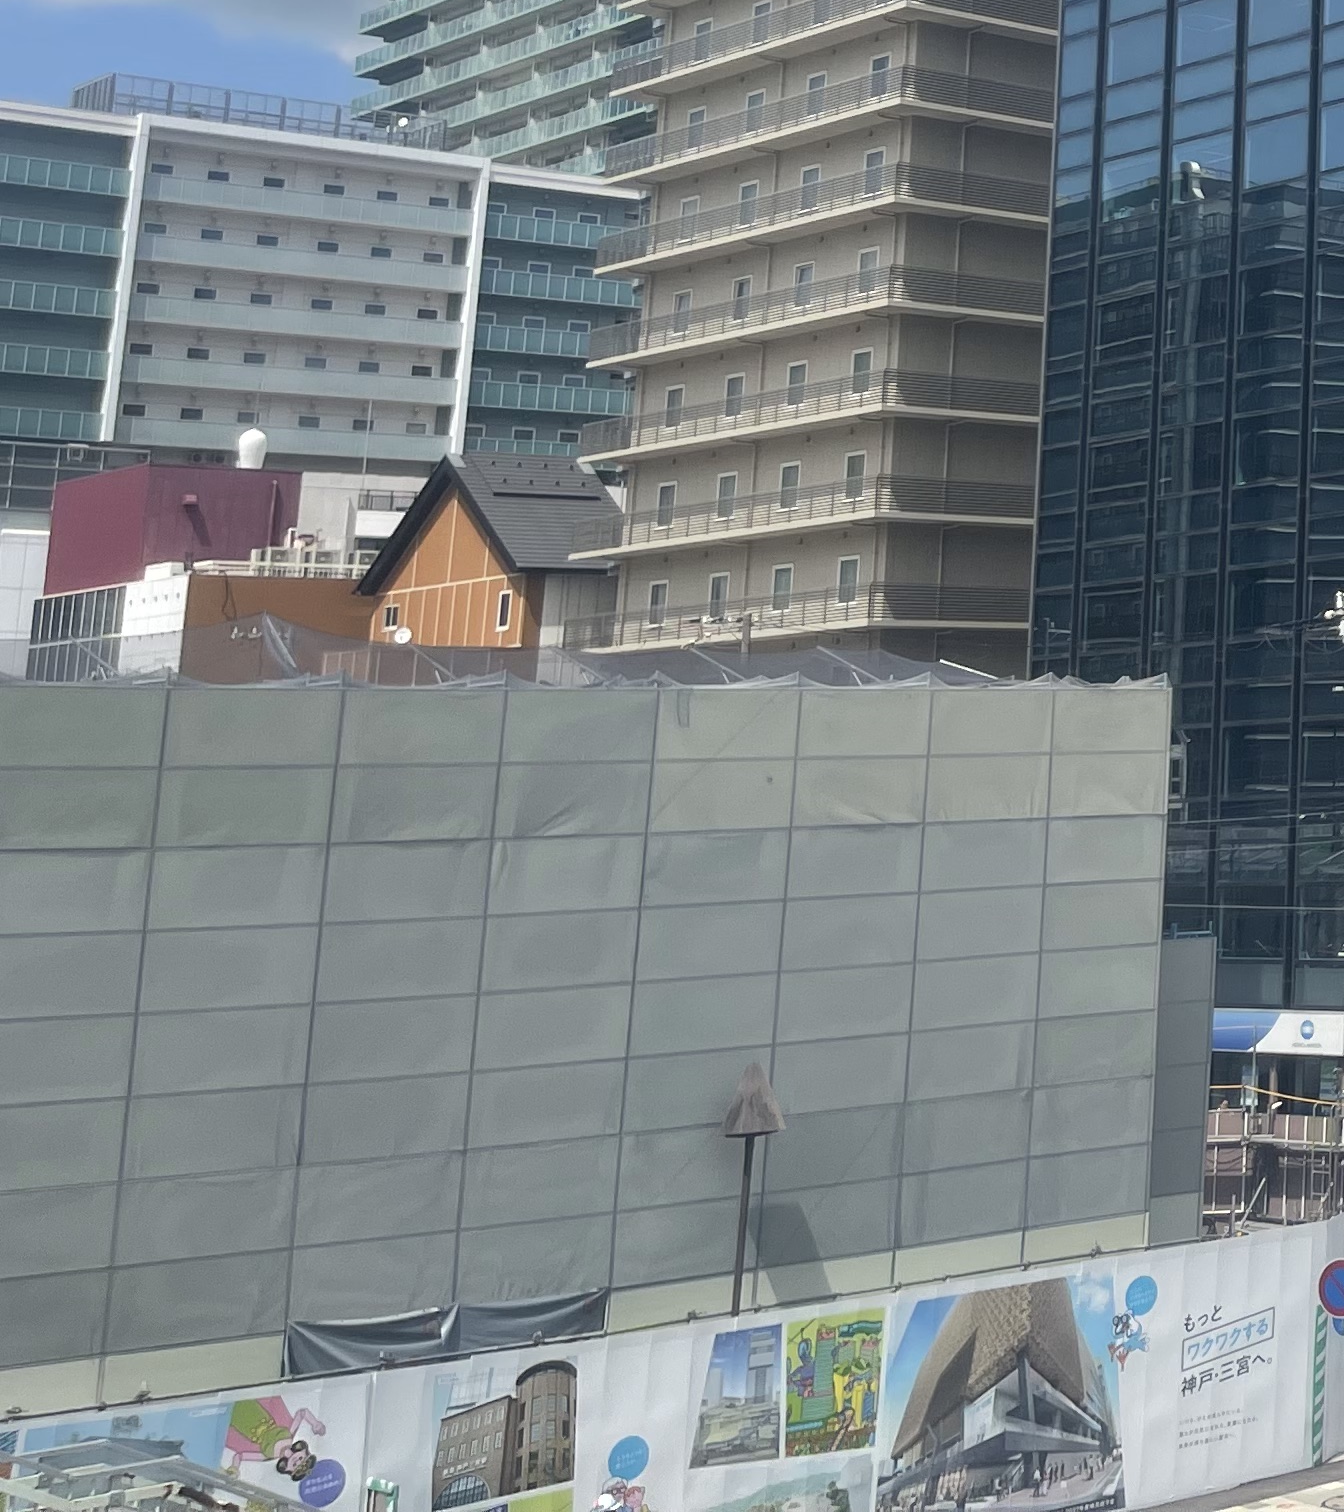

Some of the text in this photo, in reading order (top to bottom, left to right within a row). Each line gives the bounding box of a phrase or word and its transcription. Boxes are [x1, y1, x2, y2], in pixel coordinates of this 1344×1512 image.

[1184, 1305, 1222, 1333] もっと
[1187, 1317, 1269, 1362] ワクワクする
[1181, 1355, 1273, 1398] 神戸・三宮へ。
